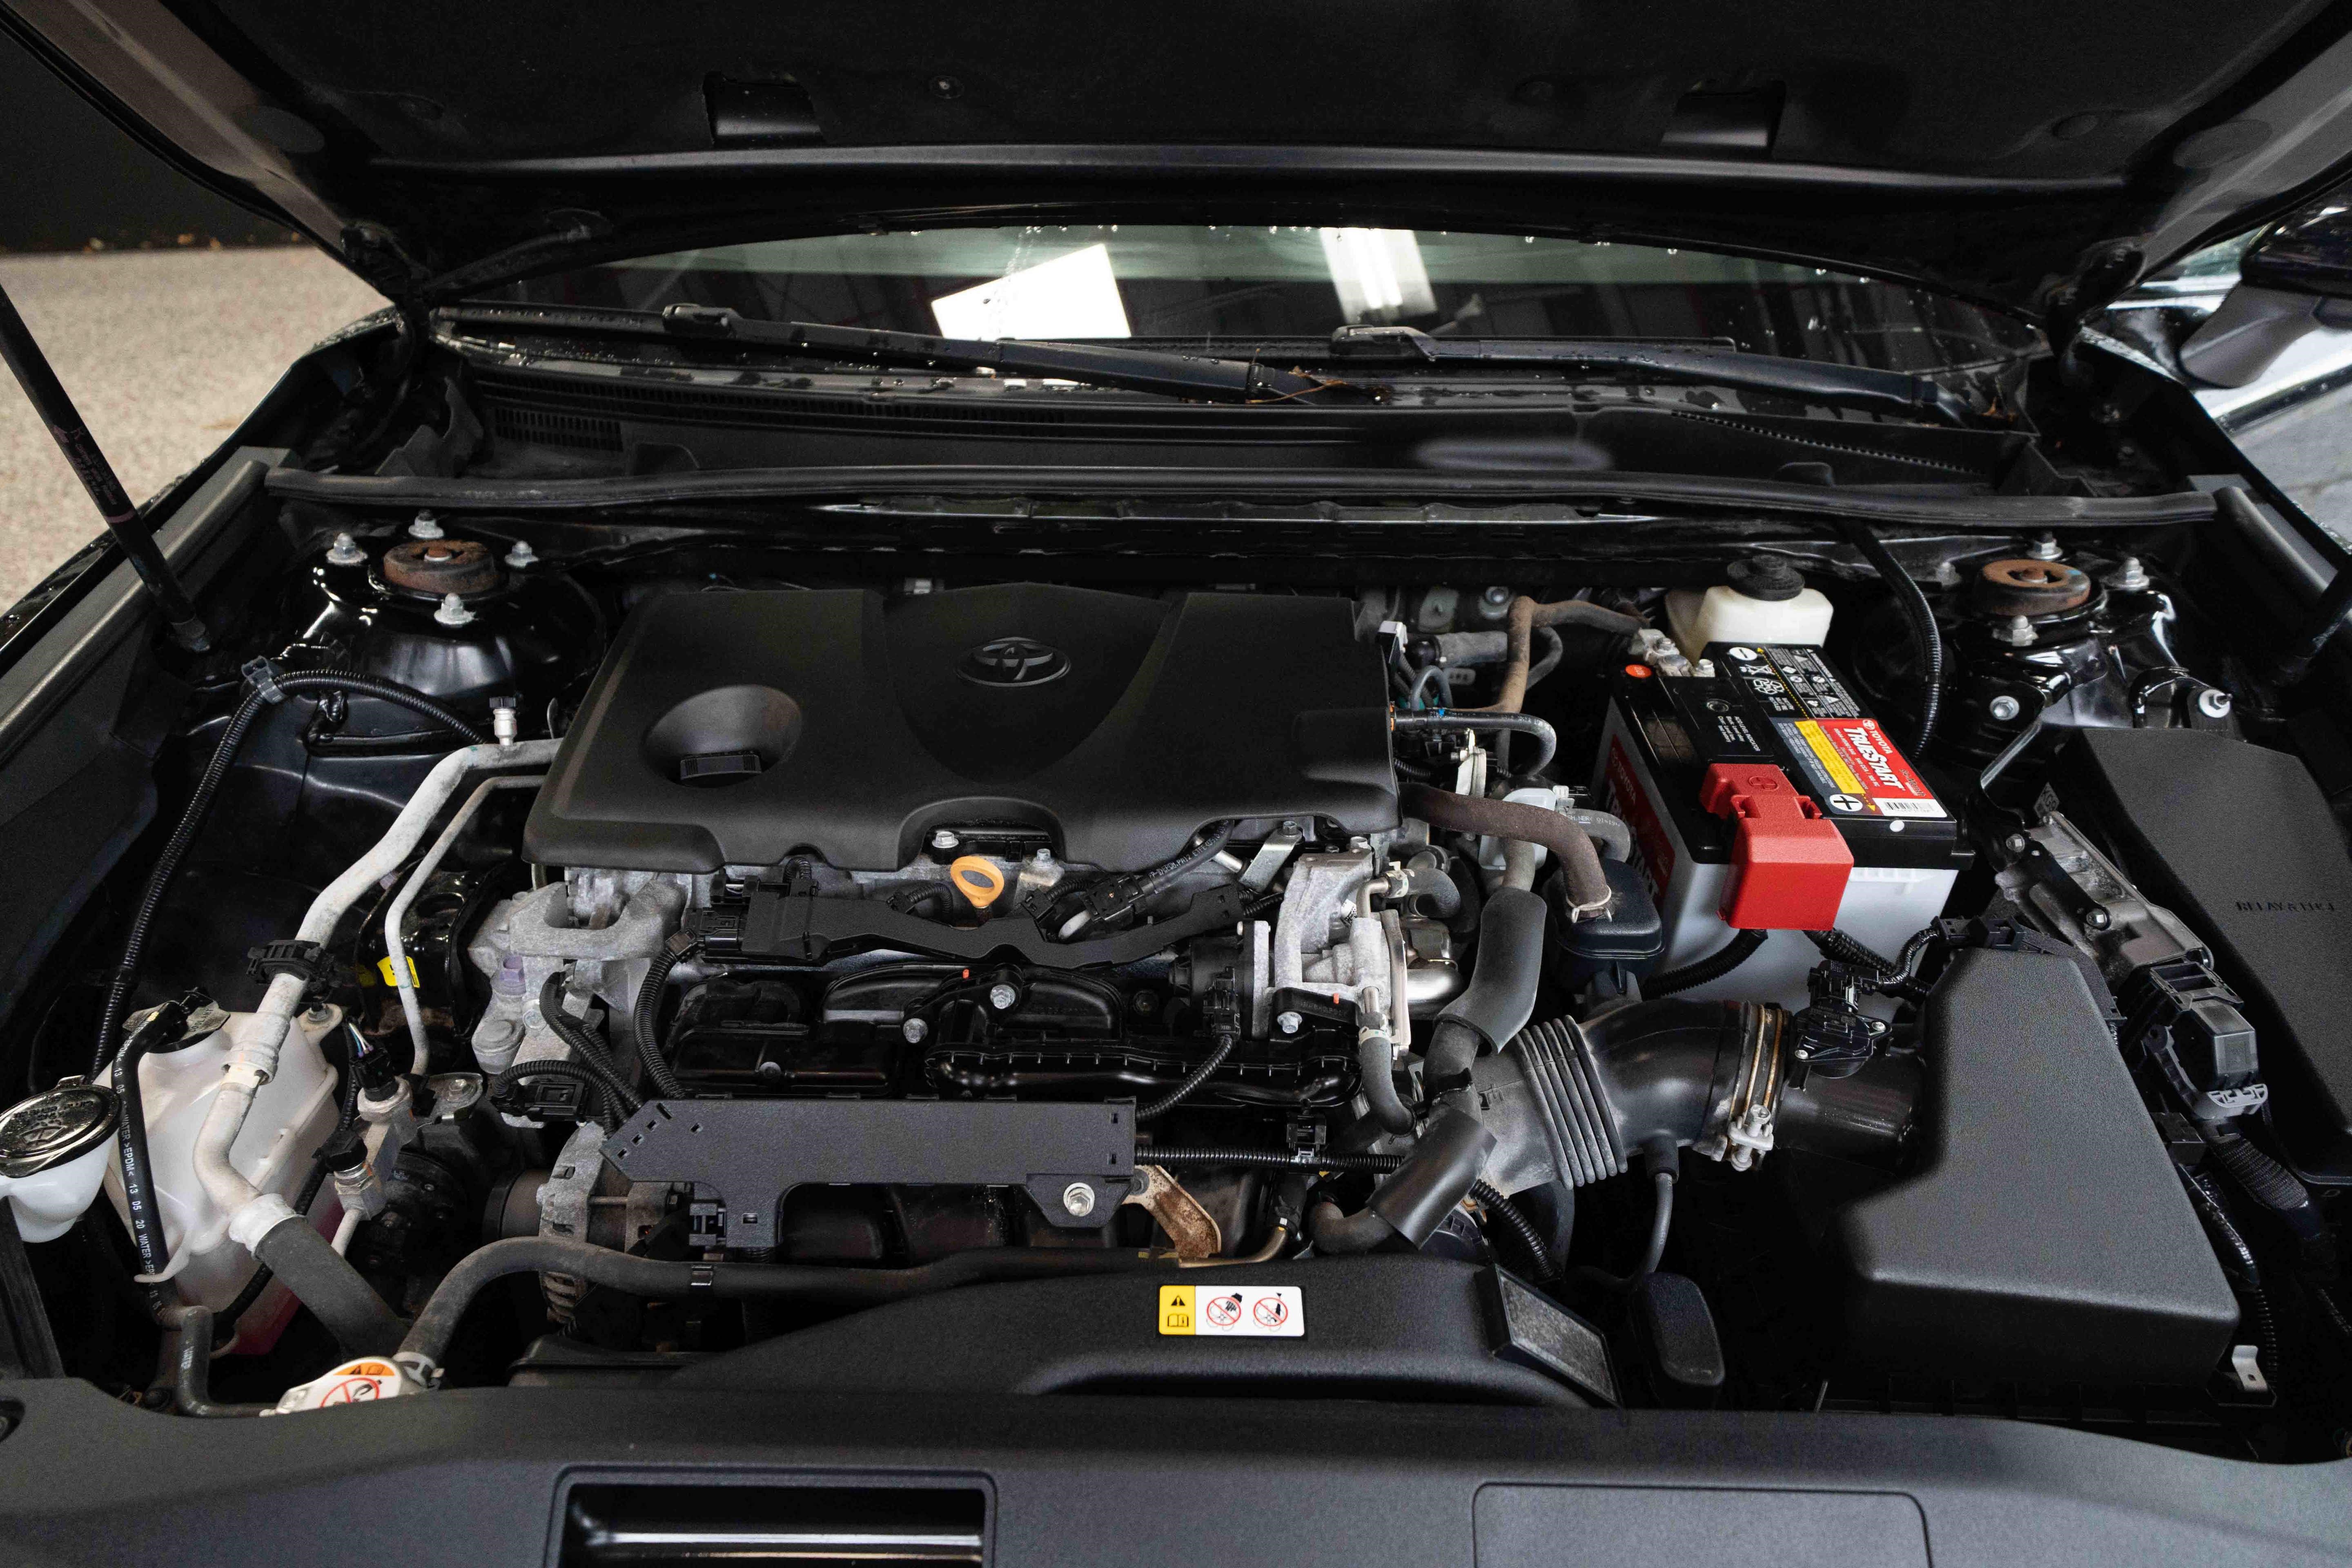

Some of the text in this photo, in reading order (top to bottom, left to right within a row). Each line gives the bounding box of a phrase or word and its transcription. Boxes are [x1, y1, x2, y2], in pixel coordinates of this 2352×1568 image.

[1739, 724, 1749, 734] LEVEL
[1745, 734, 1761, 751] INDICATOR
[1869, 731, 1893, 754] TOYOTA
[1843, 727, 1904, 791] TRUESTART
[190, 1009, 214, 1033] COOLANT
[114, 1068, 122, 1077] 13
[116, 1085, 125, 1094] 05
[128, 1184, 139, 1194] 13
[131, 1200, 142, 1211] 05
[135, 1220, 145, 1229] 20
[138, 1234, 151, 1259] WATER
